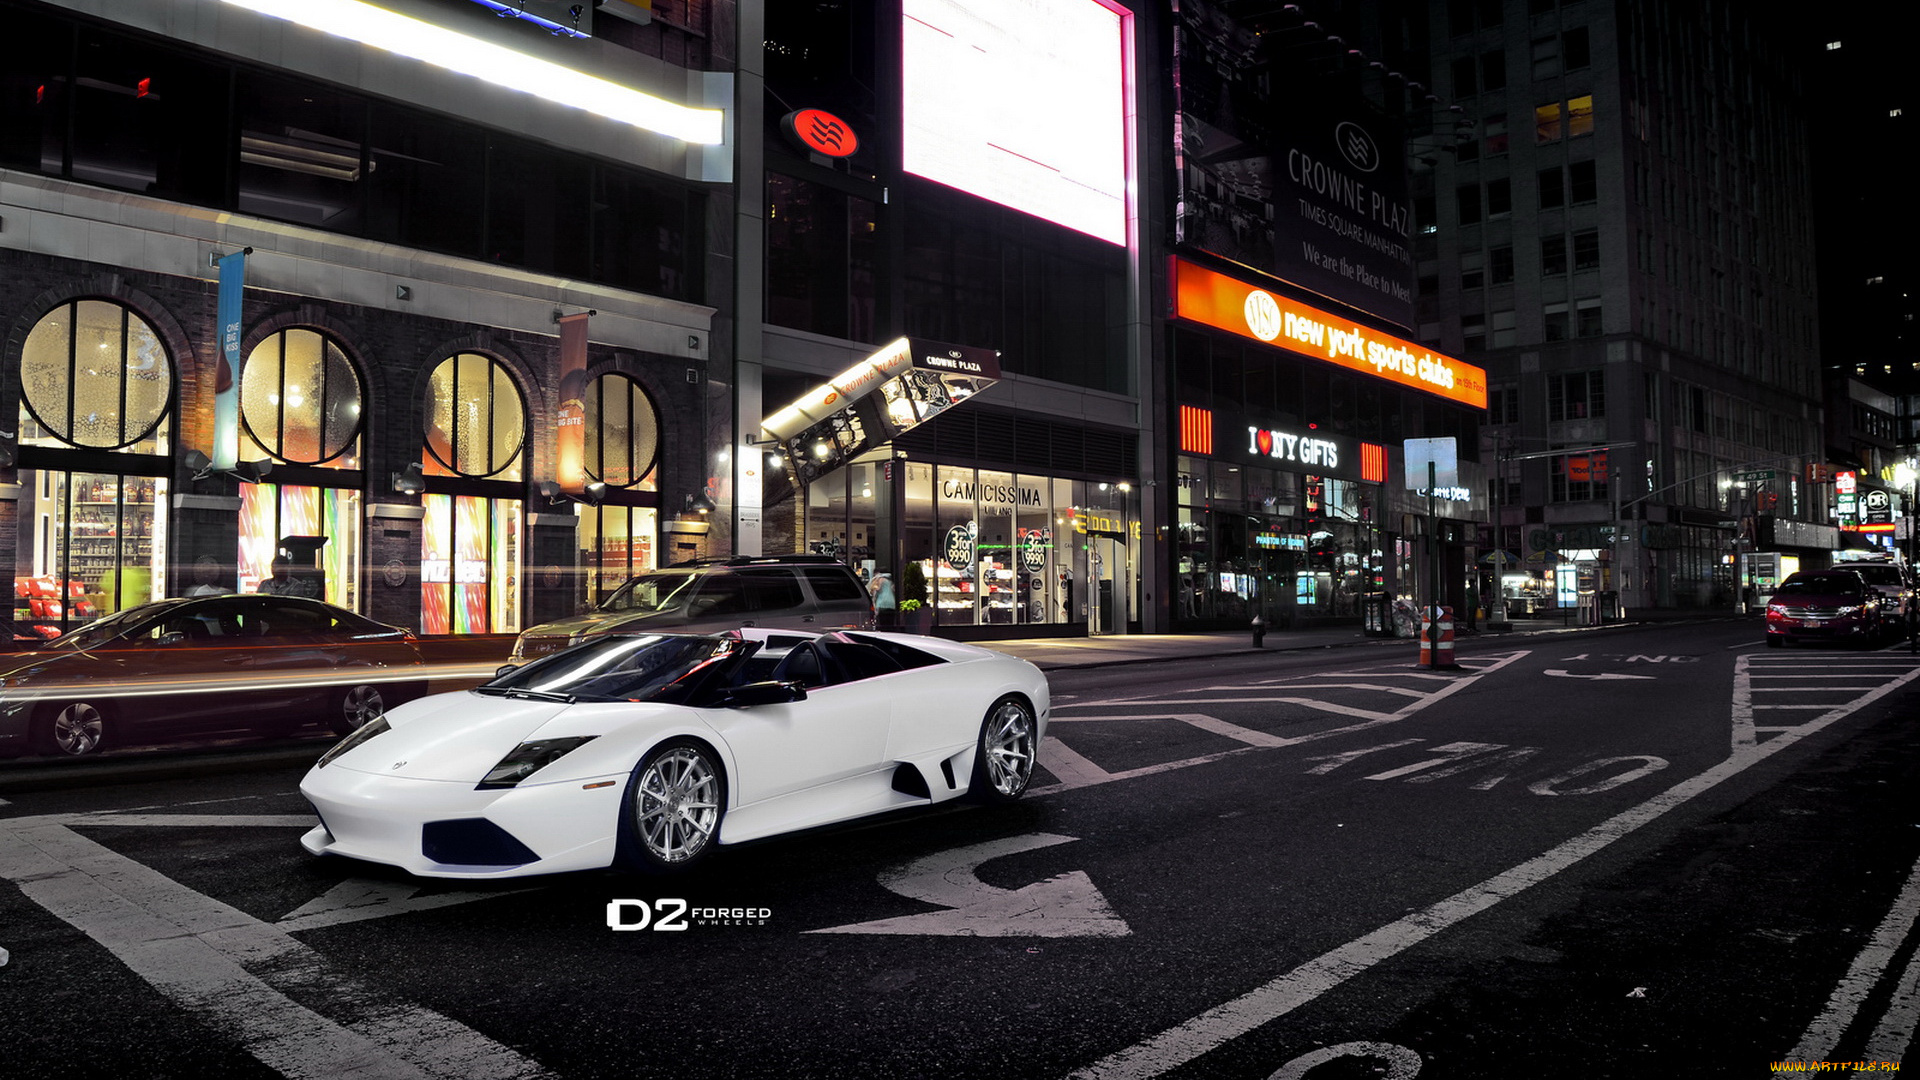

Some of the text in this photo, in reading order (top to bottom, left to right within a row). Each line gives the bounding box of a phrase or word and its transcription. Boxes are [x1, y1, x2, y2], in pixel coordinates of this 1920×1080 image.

[1288, 148, 1410, 240] CROWNE PLAZ
[1299, 198, 1327, 227] TIMES
[1328, 212, 1363, 245] SQUARE
[1302, 240, 1411, 304] We are the Place to Meet
[226, 321, 240, 333] ONE
[226, 332, 237, 343] BIG
[226, 342, 239, 351] KISS
[1285, 311, 1455, 390] new york sports clubs
[840, 352, 906, 397] CROWNE PLAZA
[926, 355, 981, 372] CROWNE PLAZA
[1248, 426, 1338, 469] I NY GIFTS
[1759, 471, 1768, 479] St
[943, 479, 1041, 507] CAMICISSIMA
[950, 530, 972, 551] 3 for
